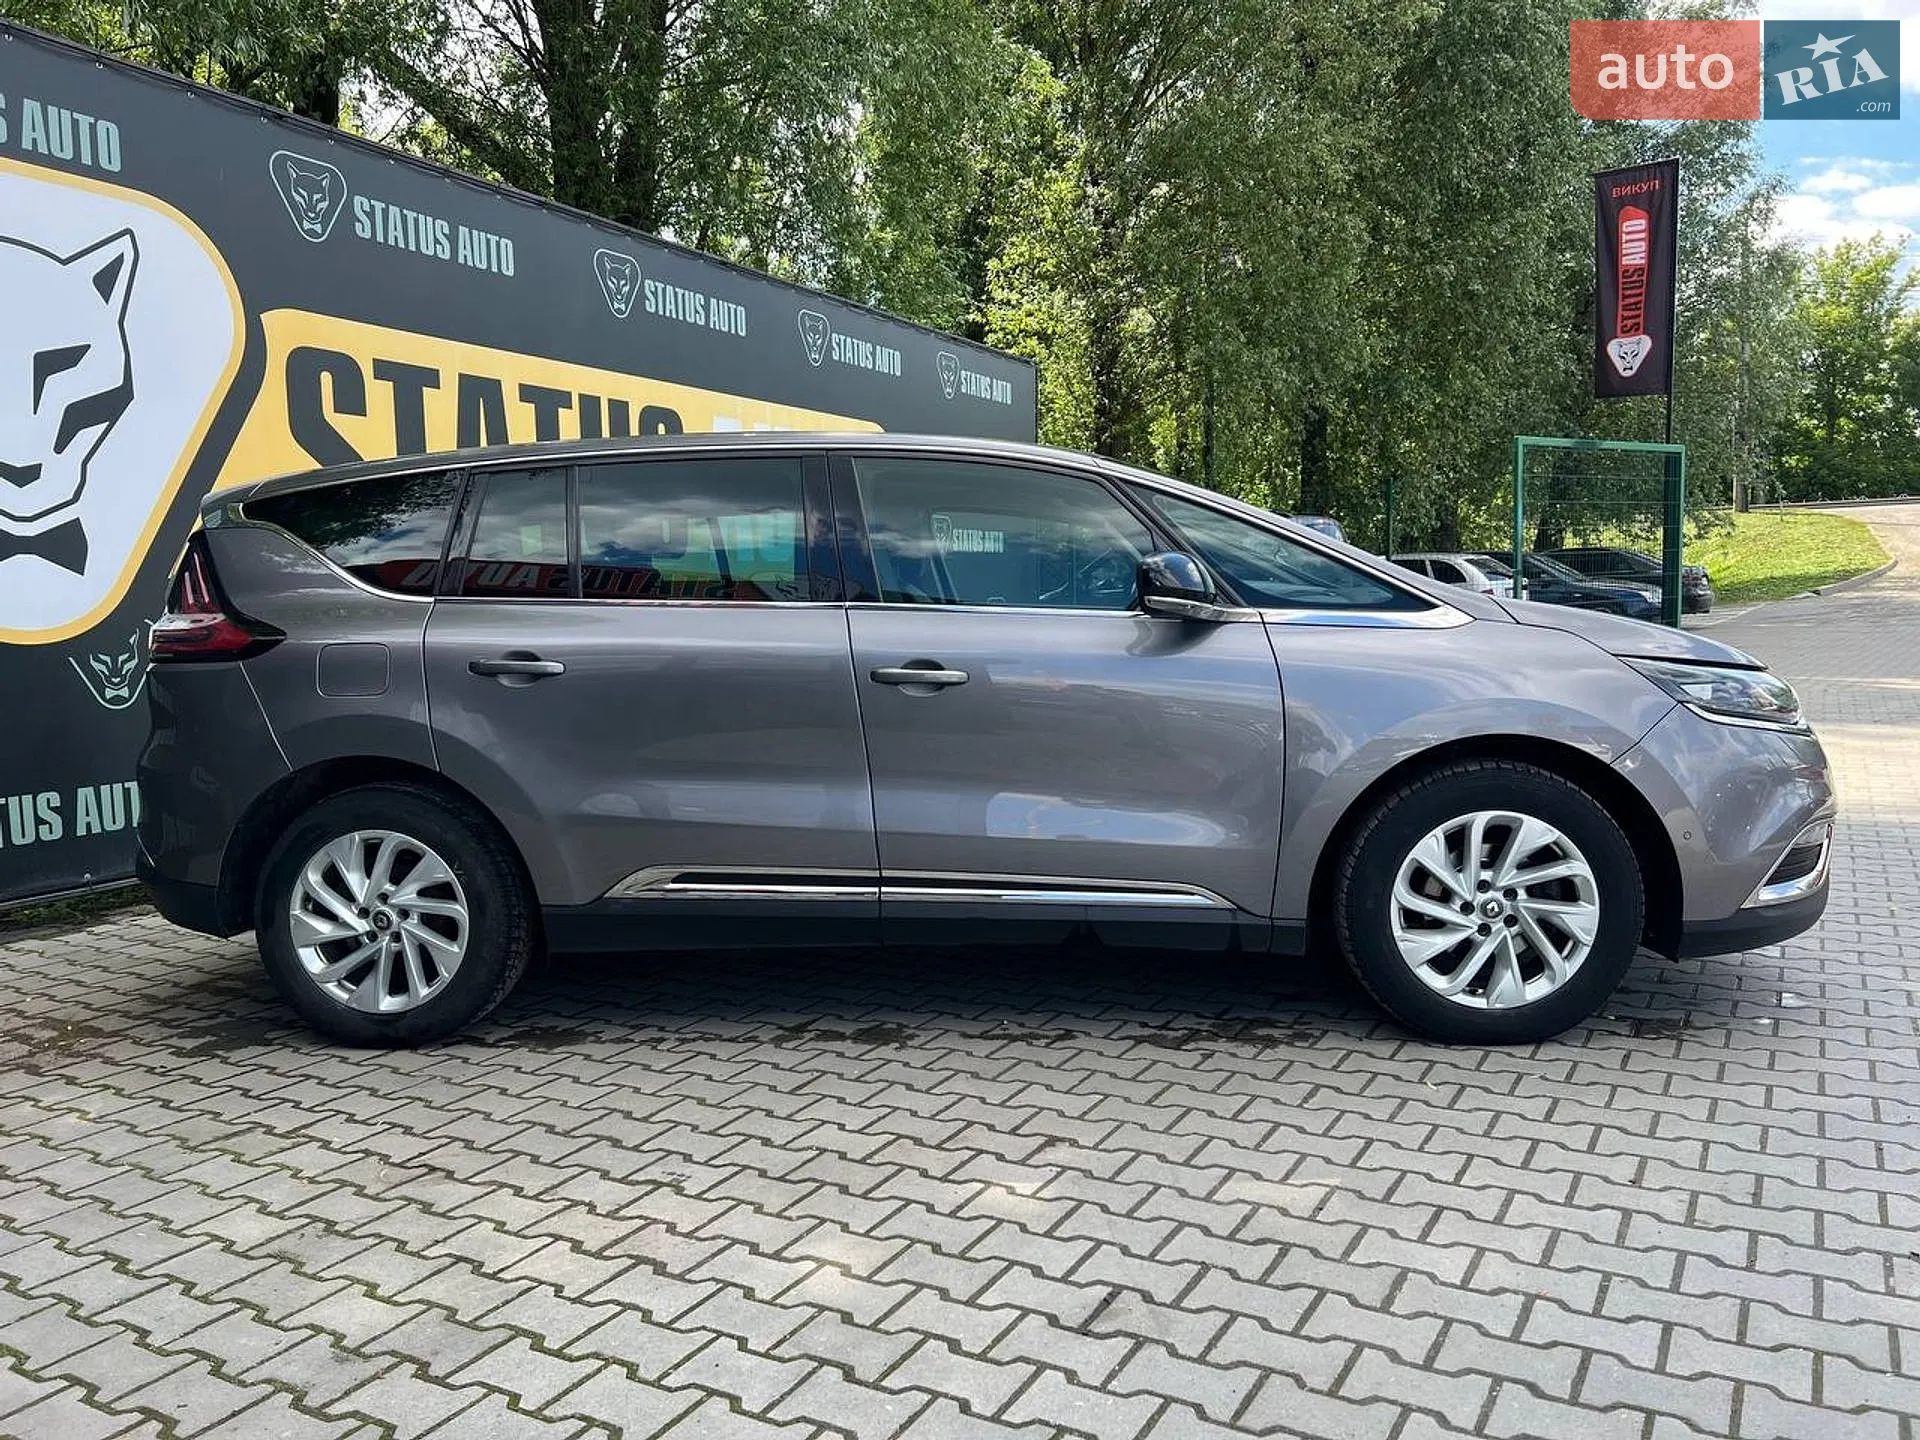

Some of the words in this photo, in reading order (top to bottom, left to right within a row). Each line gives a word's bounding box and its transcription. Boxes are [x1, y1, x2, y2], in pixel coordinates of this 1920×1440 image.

[22, 98, 121, 172] AUTO
[1611, 180, 1659, 198] ВИКУП
[353, 195, 451, 260] STATUS
[458, 225, 515, 277] AUTO
[1622, 218, 1648, 265] AUTO
[644, 279, 705, 326] STATUS
[709, 297, 746, 337] AUTO
[1621, 267, 1645, 334] STATUS
[831, 332, 873, 369] STATUS
[875, 344, 901, 377] AUTO
[960, 370, 991, 400] STATUS
[992, 378, 1012, 405] AUTO
